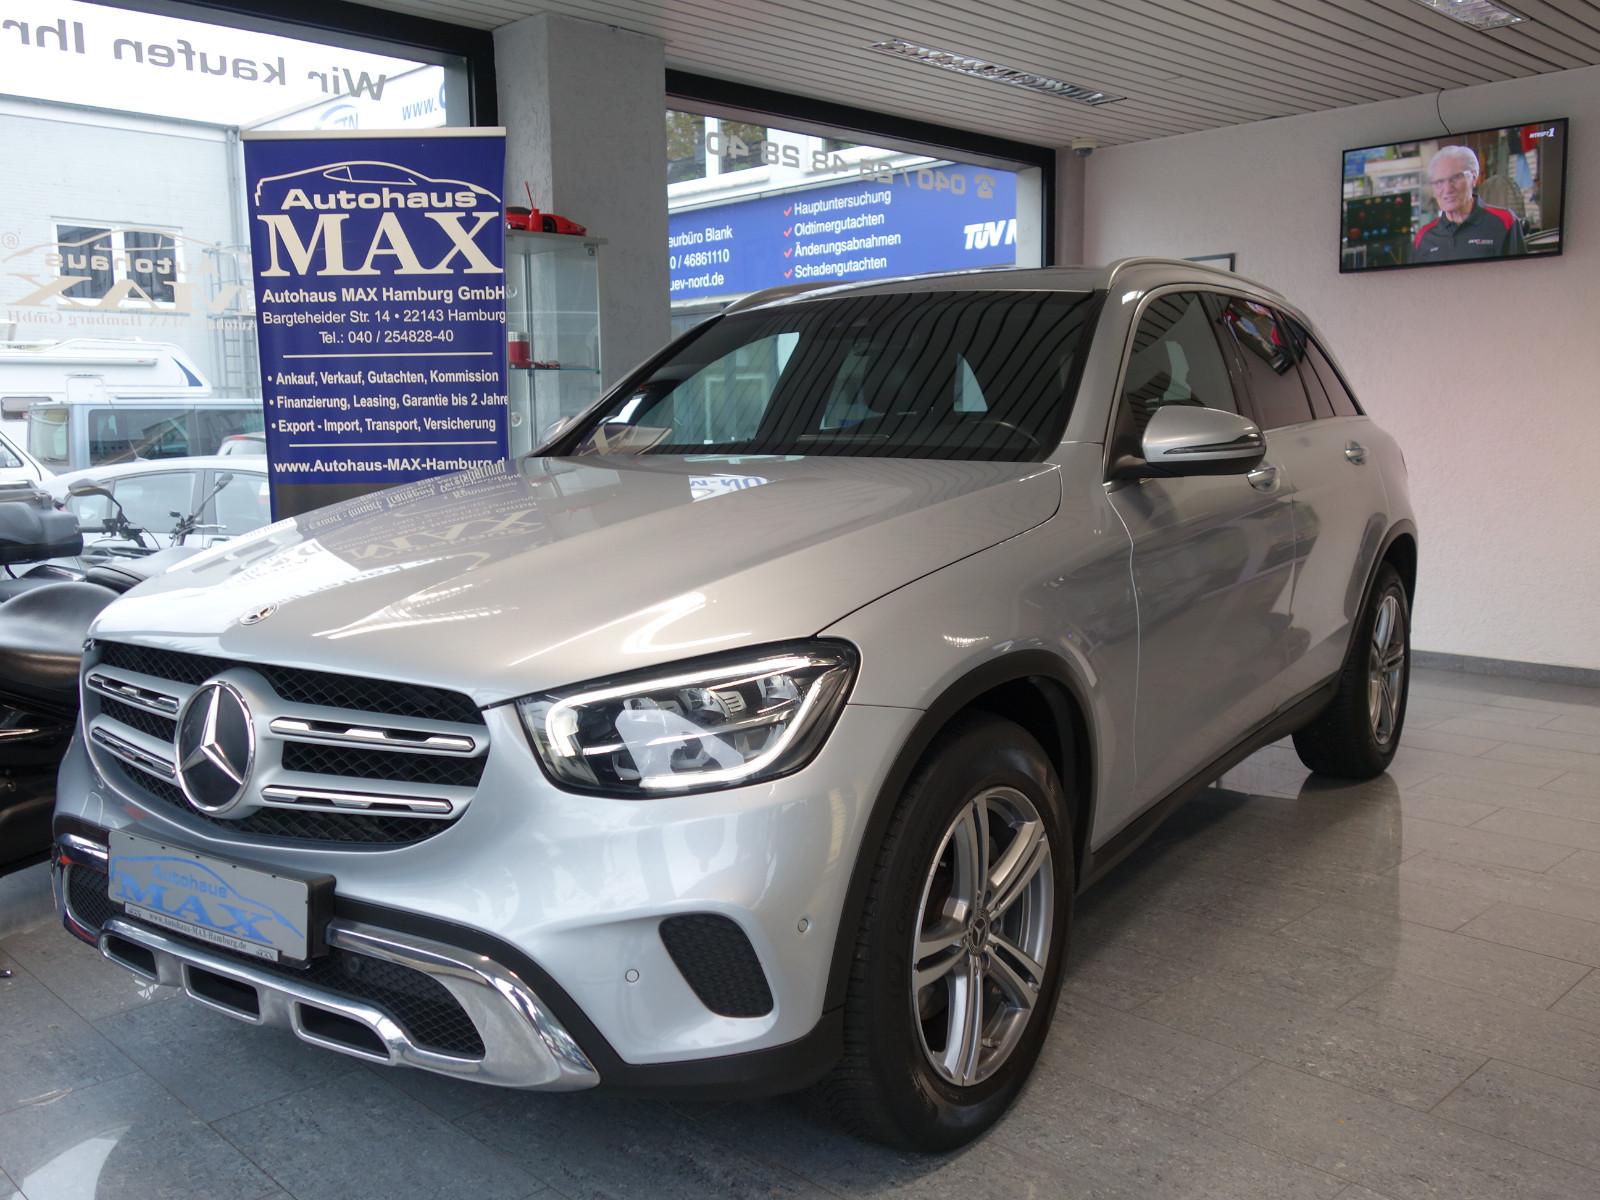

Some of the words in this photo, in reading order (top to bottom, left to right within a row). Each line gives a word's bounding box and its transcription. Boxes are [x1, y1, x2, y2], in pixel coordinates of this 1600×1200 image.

[281, 187, 478, 211] Autohaus
[794, 190, 892, 216] Hauptuntersuchung
[705, 225, 733, 243] Blank
[794, 213, 885, 237] Oldtimergutachten
[257, 211, 504, 277] MAX
[794, 233, 902, 257] Änderungsabnahmen
[684, 248, 730, 268] 46861110
[794, 257, 888, 278] Schadengutachten
[262, 289, 337, 304] Autohaus
[341, 288, 379, 302] MAX
[382, 286, 454, 304] Hamburg
[458, 286, 505, 301] GmbH
[262, 311, 346, 327] Bargteheider
[350, 312, 371, 323] Str.
[375, 311, 391, 323] 14
[403, 309, 445, 322] 22143
[448, 308, 506, 324] Hamburg
[319, 331, 344, 344] Tel.:
[348, 330, 373, 343] 040
[384, 329, 454, 343] 254828-40
[276, 372, 318, 386] Ankauf,
[320, 371, 365, 385] Verkauf,
[367, 370, 428, 384] Gutachten,
[430, 370, 499, 383] Kommission
[277, 395, 351, 411] Finanzierung,
[353, 395, 400, 410] Leasing,
[402, 393, 449, 407] Garantie
[451, 393, 468, 406] bis
[471, 394, 478, 406] 2
[480, 392, 509, 406] Jahre
[278, 419, 315, 434] Export
[324, 419, 362, 433] Import,
[365, 418, 421, 432] Transport,
[424, 416, 496, 432] Versicherung
[153, 864, 229, 898] Autohaus
[115, 871, 274, 945] MAX
